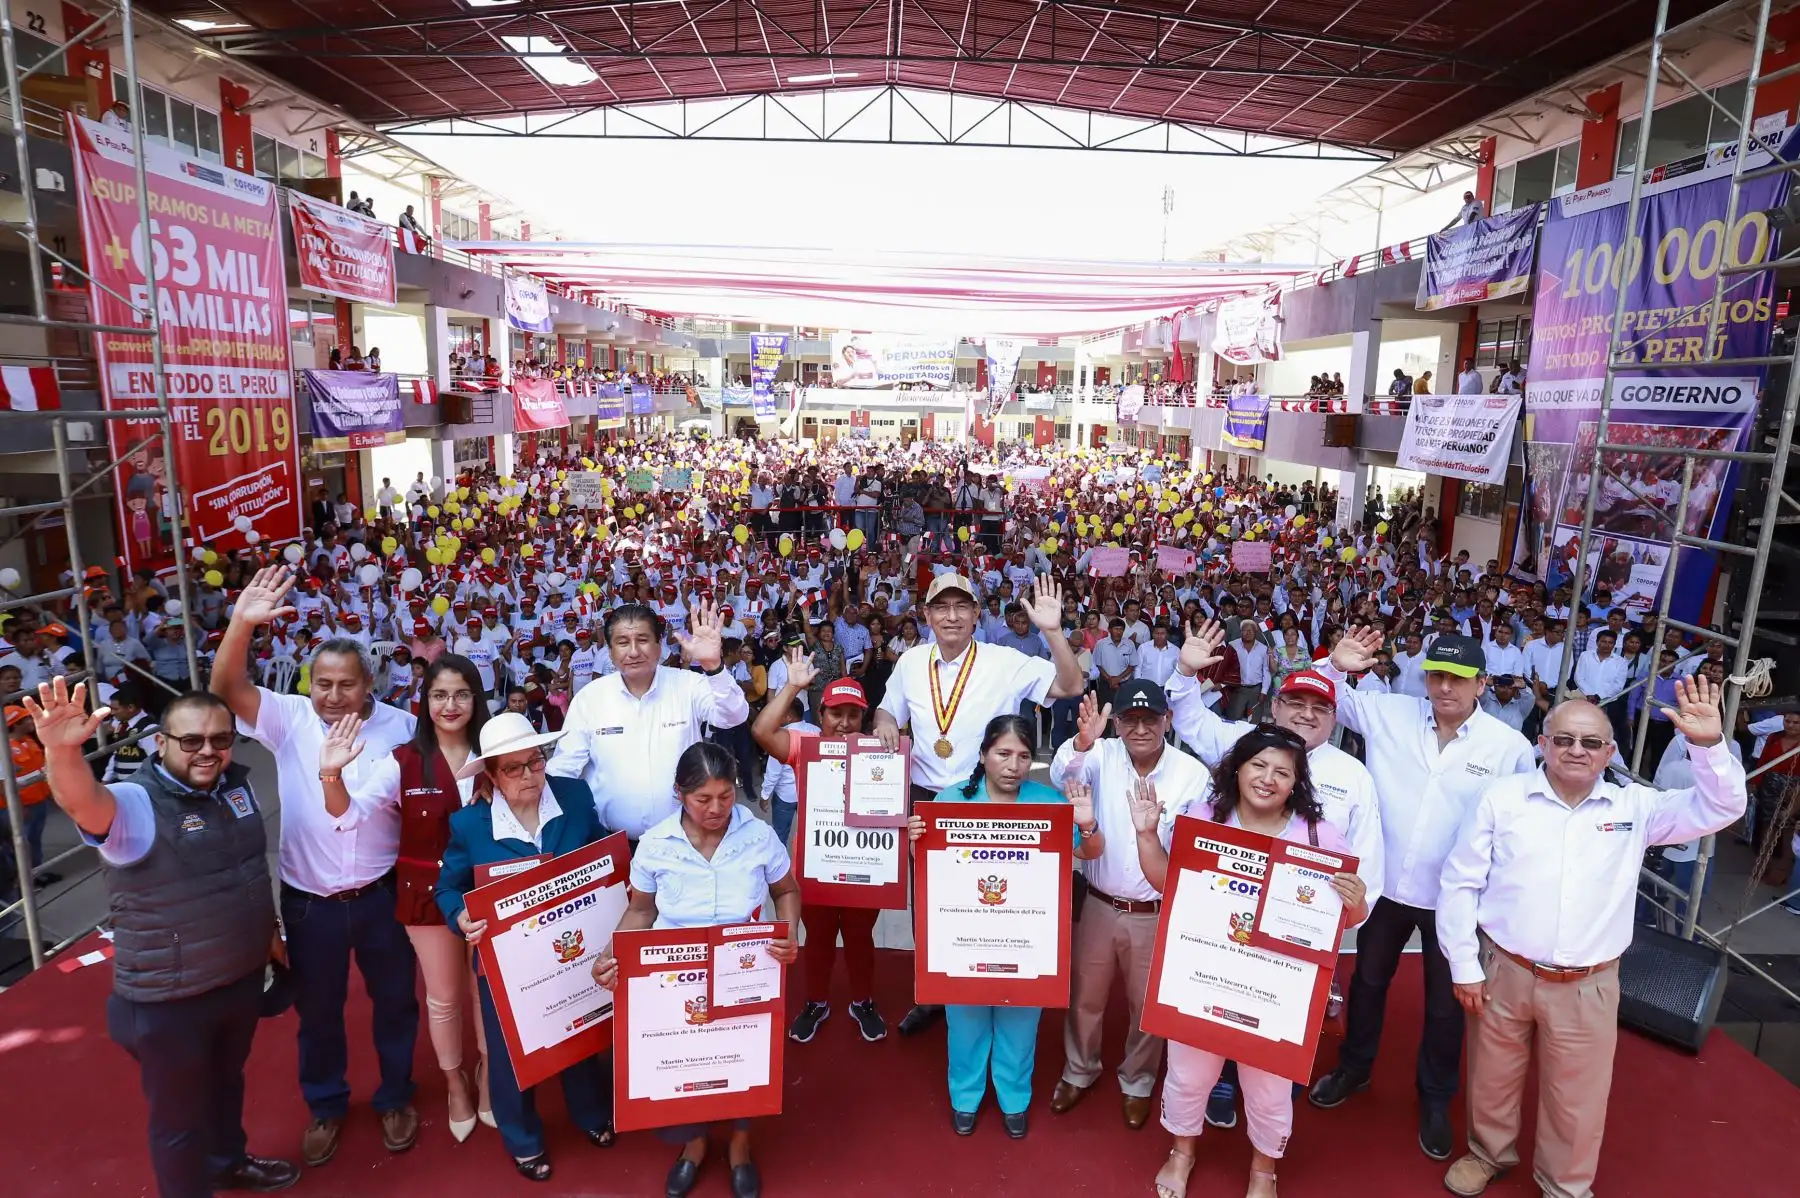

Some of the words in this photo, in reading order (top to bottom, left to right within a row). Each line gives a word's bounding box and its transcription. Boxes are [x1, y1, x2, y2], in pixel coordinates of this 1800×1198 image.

[26, 10, 47, 35] 22
[309, 138, 318, 152] 21
[1723, 131, 1783, 158] COOPRI
[91, 176, 208, 221] ¡SUPRAMOS
[212, 210, 231, 229] LA
[52, 235, 66, 254] 11
[1562, 237, 1643, 300] 100
[1653, 211, 1769, 285] 000
[206, 244, 269, 298] MIL
[129, 283, 272, 336] FAMILIAS
[1533, 324, 1576, 343] NUEVOS
[1580, 298, 1771, 336] PROPIETARIOS
[107, 340, 176, 355] convertas
[190, 338, 285, 361] PROPIETARIAS
[1564, 351, 1599, 367] TODO
[1641, 328, 1728, 364] PERÚ
[128, 372, 155, 394] EN
[165, 371, 213, 394] TODO
[219, 374, 235, 394] EL
[241, 370, 278, 395] PERÚ
[877, 372, 950, 380] PROPIETARIOS
[1540, 388, 1552, 402] LO
[1553, 386, 1575, 404] QUE
[1621, 385, 1741, 405] GOBIERNO
[184, 424, 203, 441] EL
[206, 407, 290, 456] 2019
[1448, 429, 1496, 442] PROPIEDAD
[1442, 442, 1488, 455] PERUANOS
[938, 819, 974, 829] TÍTULO
[992, 822, 1049, 830] PROPIEDAD
[813, 829, 849, 848] 100
[856, 831, 894, 850] 000
[950, 833, 987, 841] POSTA
[990, 833, 1035, 841] MEDICA
[971, 850, 1029, 861] COFOPRI
[1197, 839, 1238, 857] TÍTULO
[1239, 850, 1256, 862] DE
[1232, 863, 1265, 878] COLE
[498, 889, 536, 911] TÍTULO
[538, 881, 553, 893] DE
[554, 858, 611, 887] PROPIEDAD
[523, 875, 592, 909] REGISTRADO
[538, 893, 597, 926] COFOPRI
[643, 946, 684, 956] TÍTULO
[1180, 934, 1218, 949] Presidencia
[1219, 943, 1229, 951] de
[1229, 945, 1236, 953] la
[1237, 948, 1271, 963] República
[1272, 957, 1284, 967] del
[1285, 961, 1302, 973] Perú
[520, 972, 556, 993] Presidencia
[556, 968, 564, 976] de
[1219, 976, 1248, 990] Vizcarra
[1249, 985, 1277, 1000] Cornejo
[642, 1030, 679, 1039] Presidencia
[697, 1025, 730, 1034] República
[660, 1058, 684, 1066] Martín
[715, 1053, 741, 1061] Cornejo
